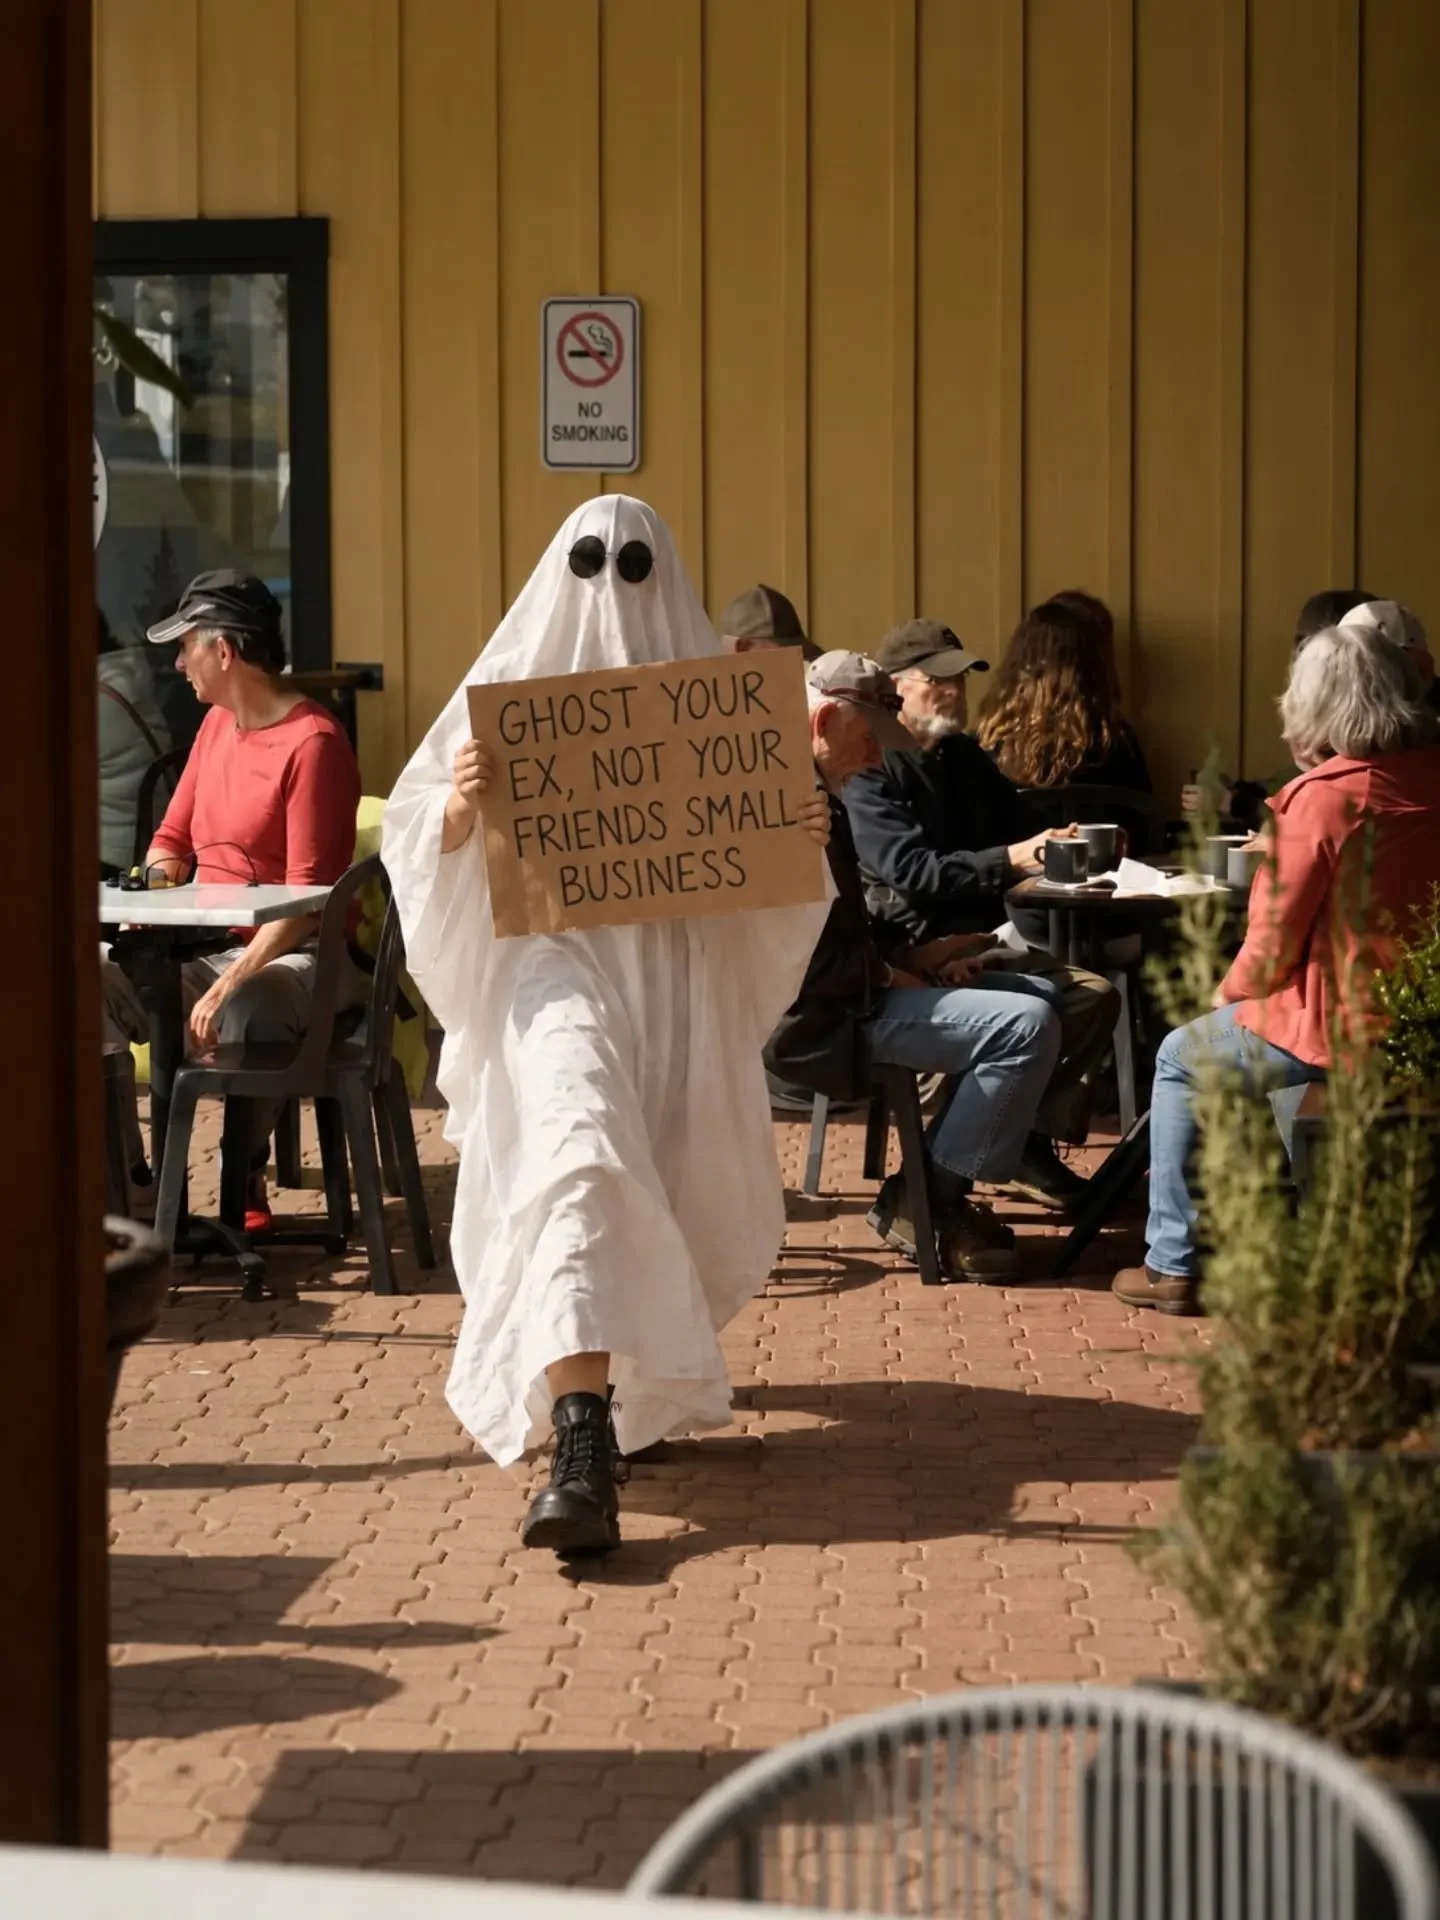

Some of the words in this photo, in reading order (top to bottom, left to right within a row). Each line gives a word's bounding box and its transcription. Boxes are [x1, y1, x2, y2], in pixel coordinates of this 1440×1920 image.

[552, 425, 629, 442] SMOKING
[578, 402, 603, 418] NO
[499, 686, 639, 746] GHOST
[660, 671, 771, 725] YOUR
[509, 754, 575, 802] EX,
[592, 742, 666, 792] NOT
[688, 729, 789, 778] YOUR
[513, 801, 668, 858] FRIENDS
[686, 789, 798, 837] SMALL
[560, 847, 746, 907] BUSINESS
